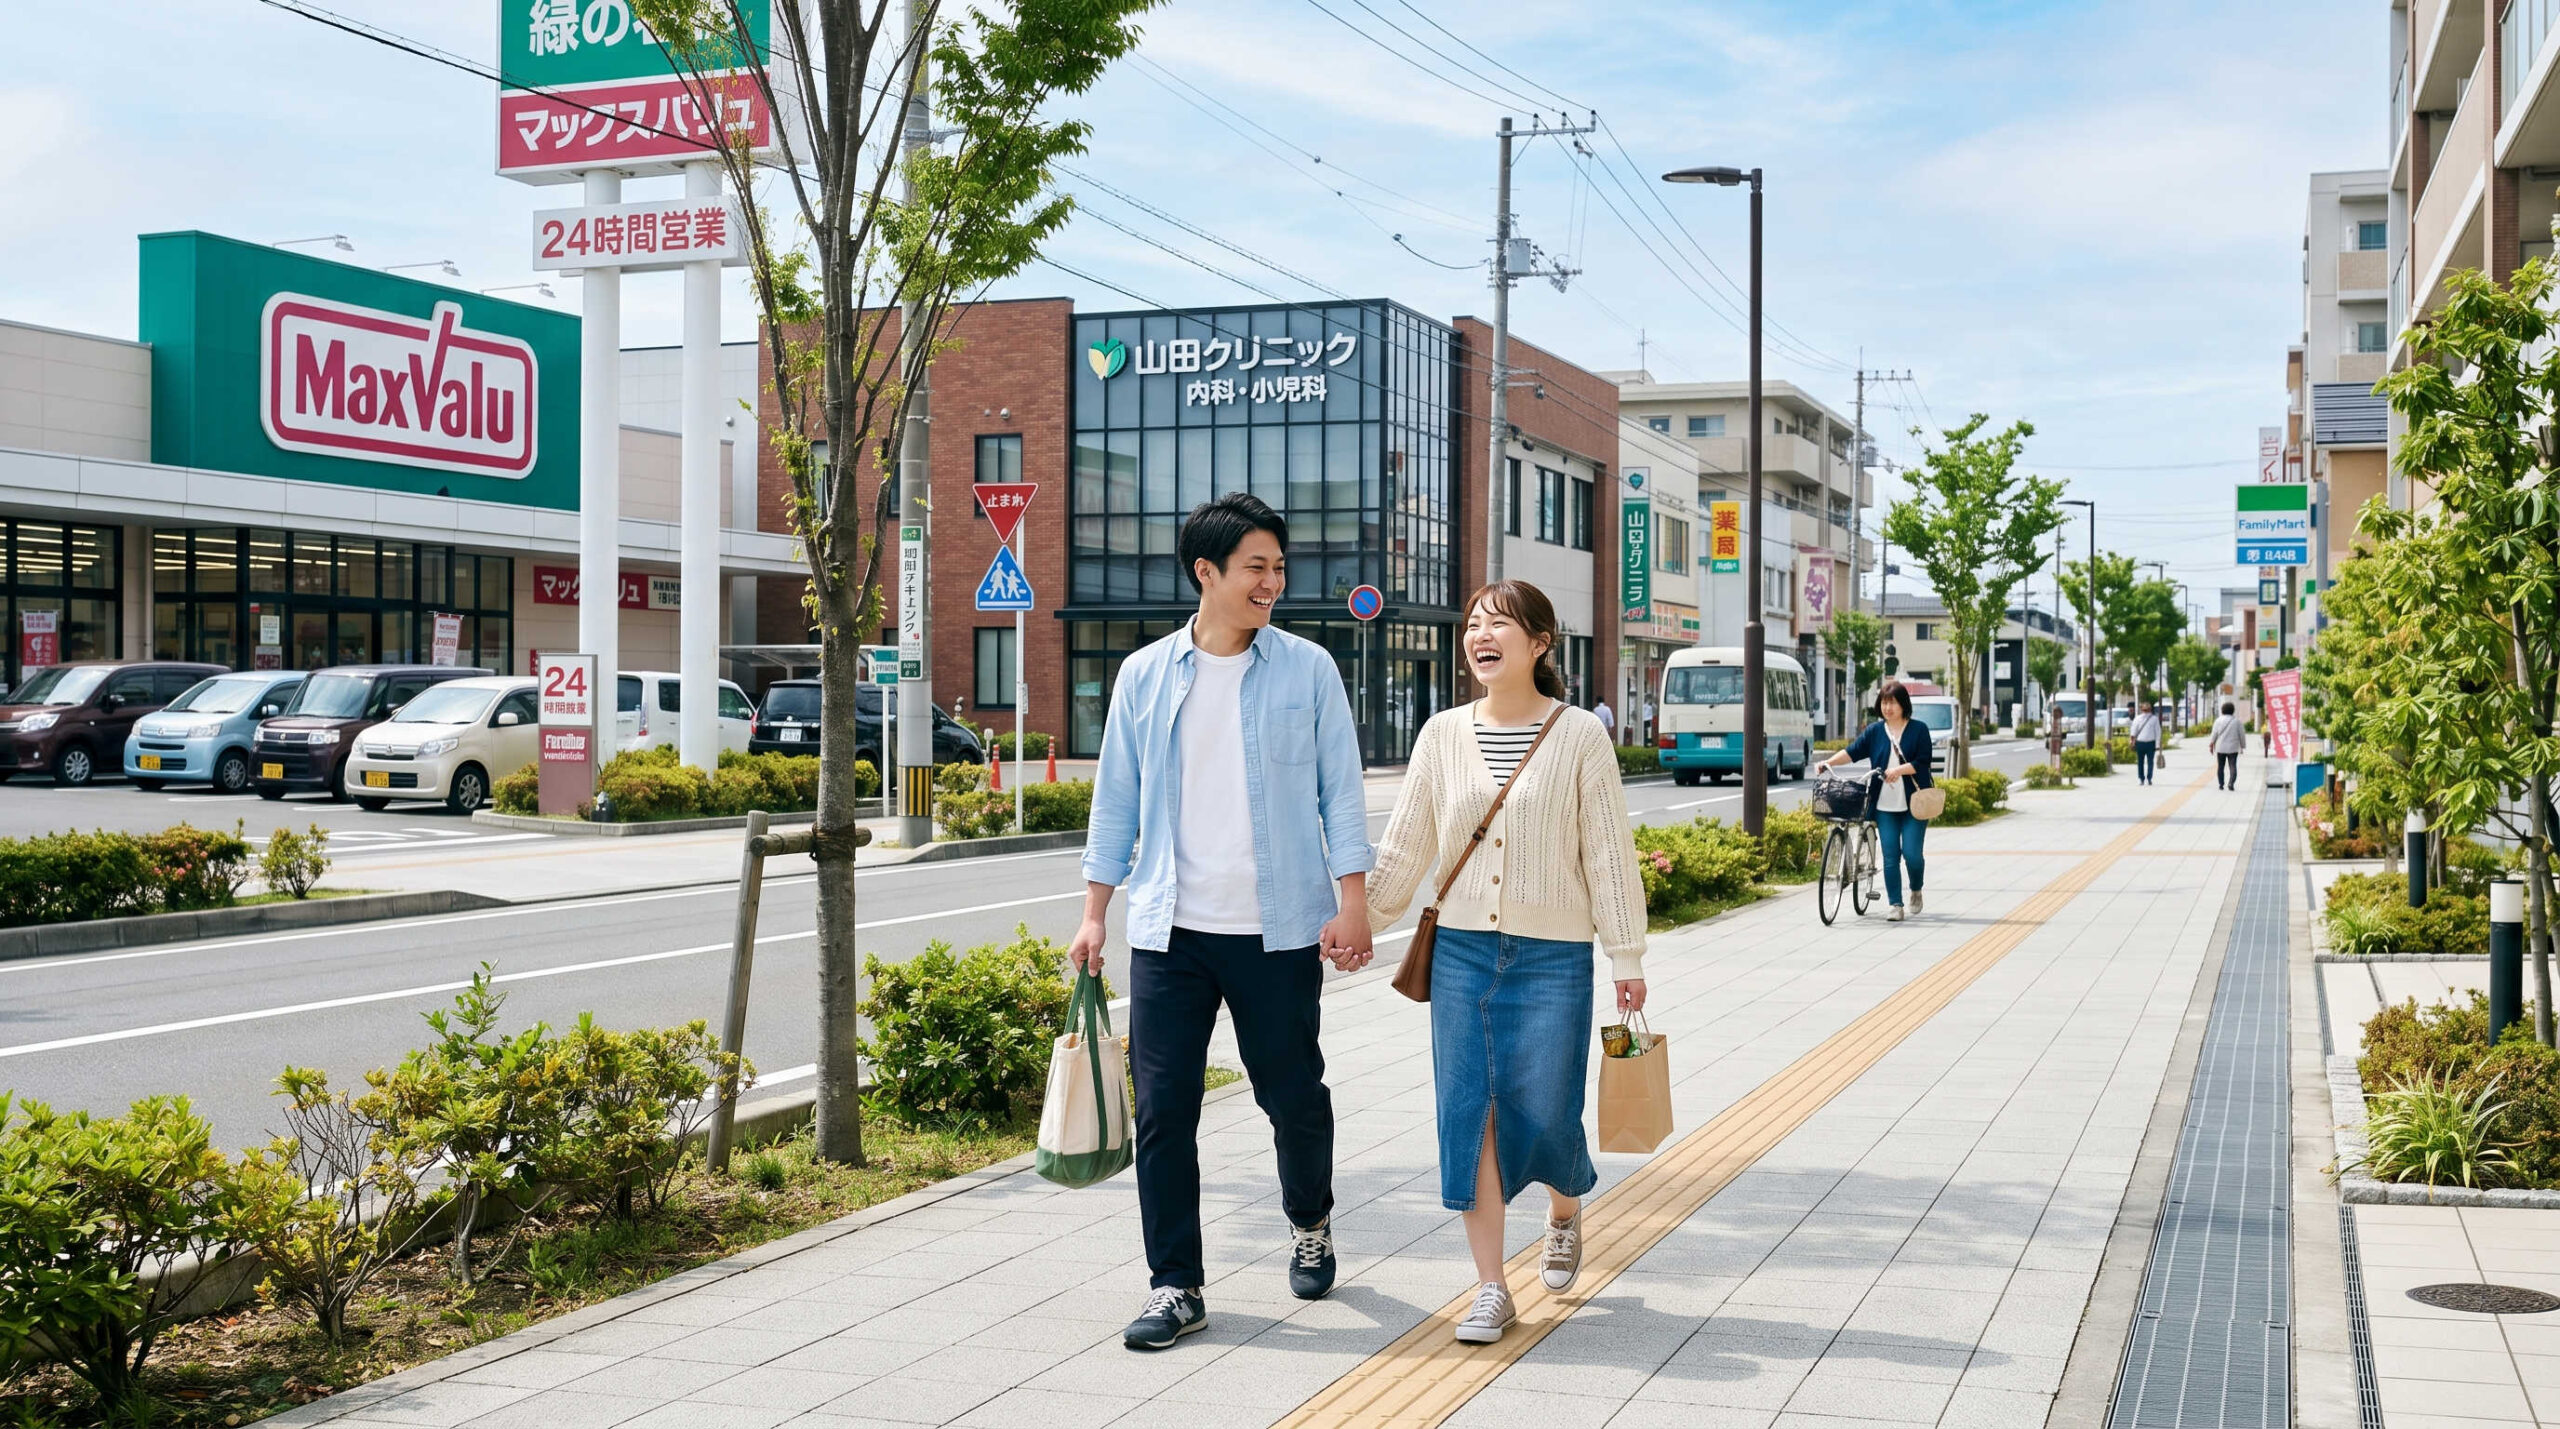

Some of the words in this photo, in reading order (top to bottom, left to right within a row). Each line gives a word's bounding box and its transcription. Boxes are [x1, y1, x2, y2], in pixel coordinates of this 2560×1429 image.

[515, 93, 757, 151] マックスバリュ
[541, 206, 727, 259] 24時間営業
[1135, 331, 1357, 375] 山田クリニック
[296, 310, 514, 444] MaxValu
[1186, 374, 1328, 407] 内科・小児科
[986, 493, 1025, 508] 止まれ
[2238, 519, 2306, 532] FamilyMart
[544, 666, 588, 698] 24
